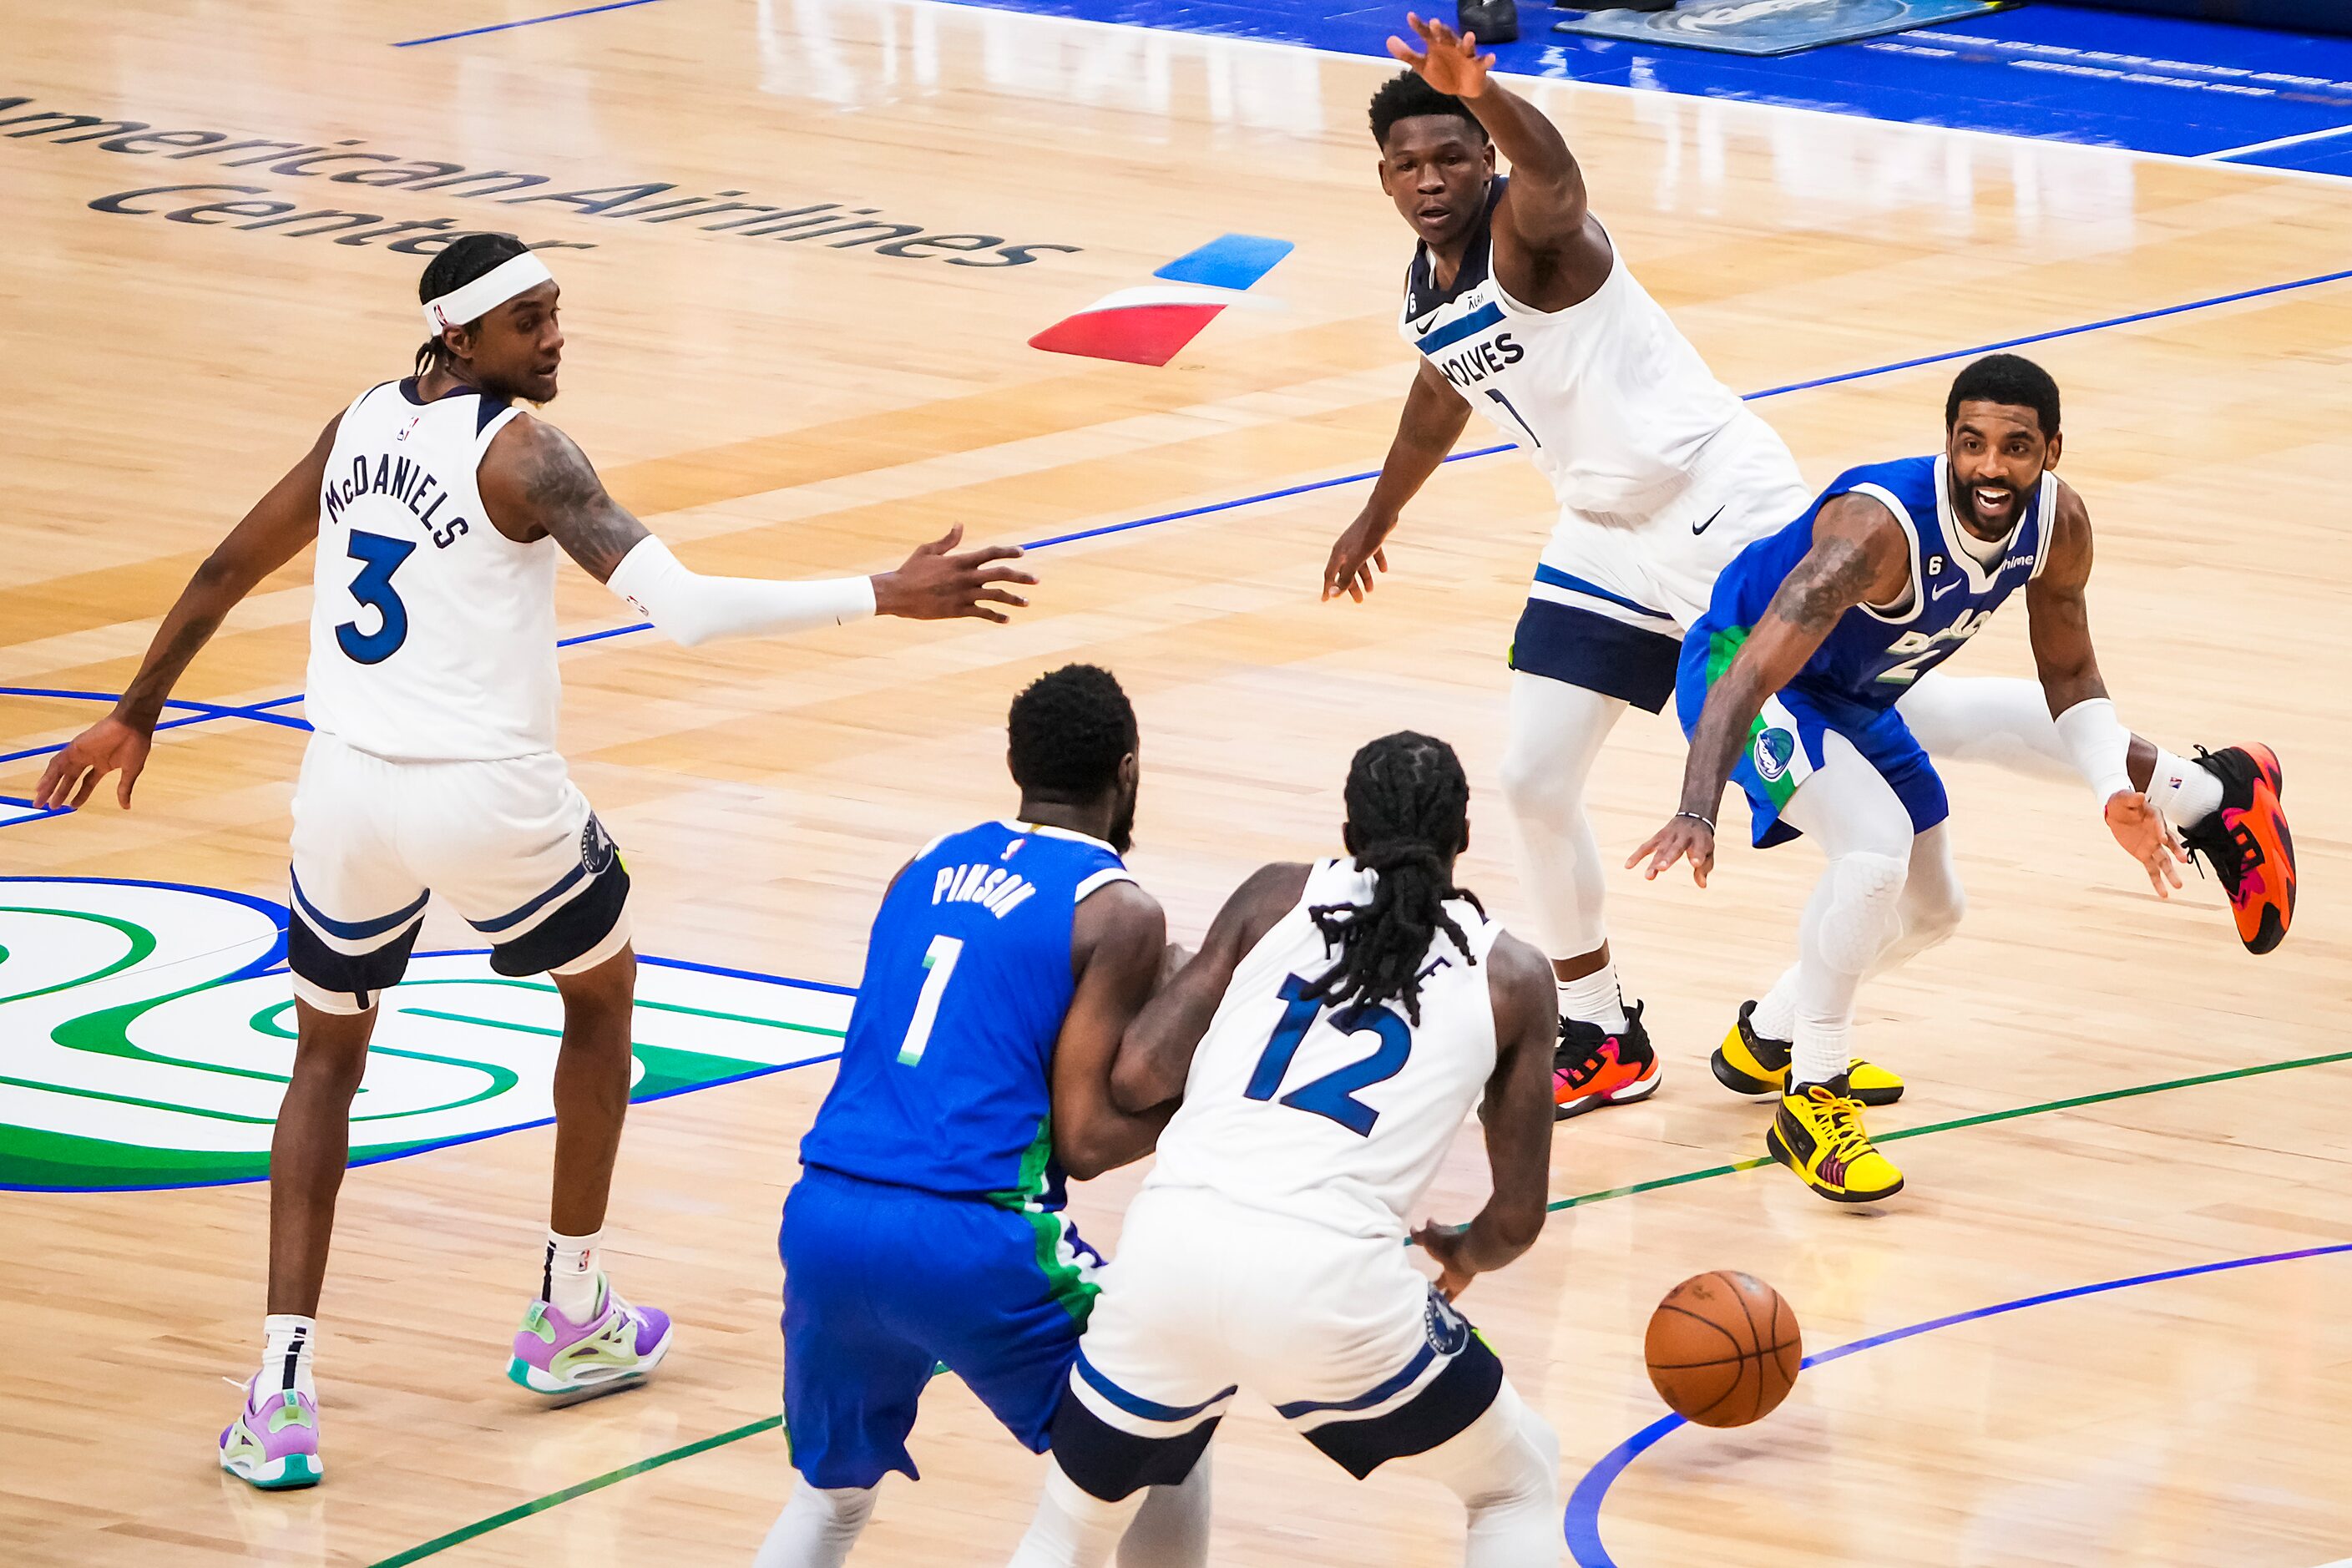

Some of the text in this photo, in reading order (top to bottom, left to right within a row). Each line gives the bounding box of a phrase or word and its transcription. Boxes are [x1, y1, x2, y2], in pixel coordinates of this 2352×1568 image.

[0, 96, 1083, 267] merican Airlines
[87, 184, 599, 256] Center
[1409, 292, 1417, 314] 6
[1484, 388, 1542, 448] 1
[325, 453, 468, 549] McDANIELS
[335, 529, 417, 665] 3
[1929, 556, 1943, 575] 6
[2002, 554, 2034, 571] hime
[931, 862, 1037, 919] PINSON
[896, 934, 964, 1067] 1
[1243, 972, 1412, 1138] 12
